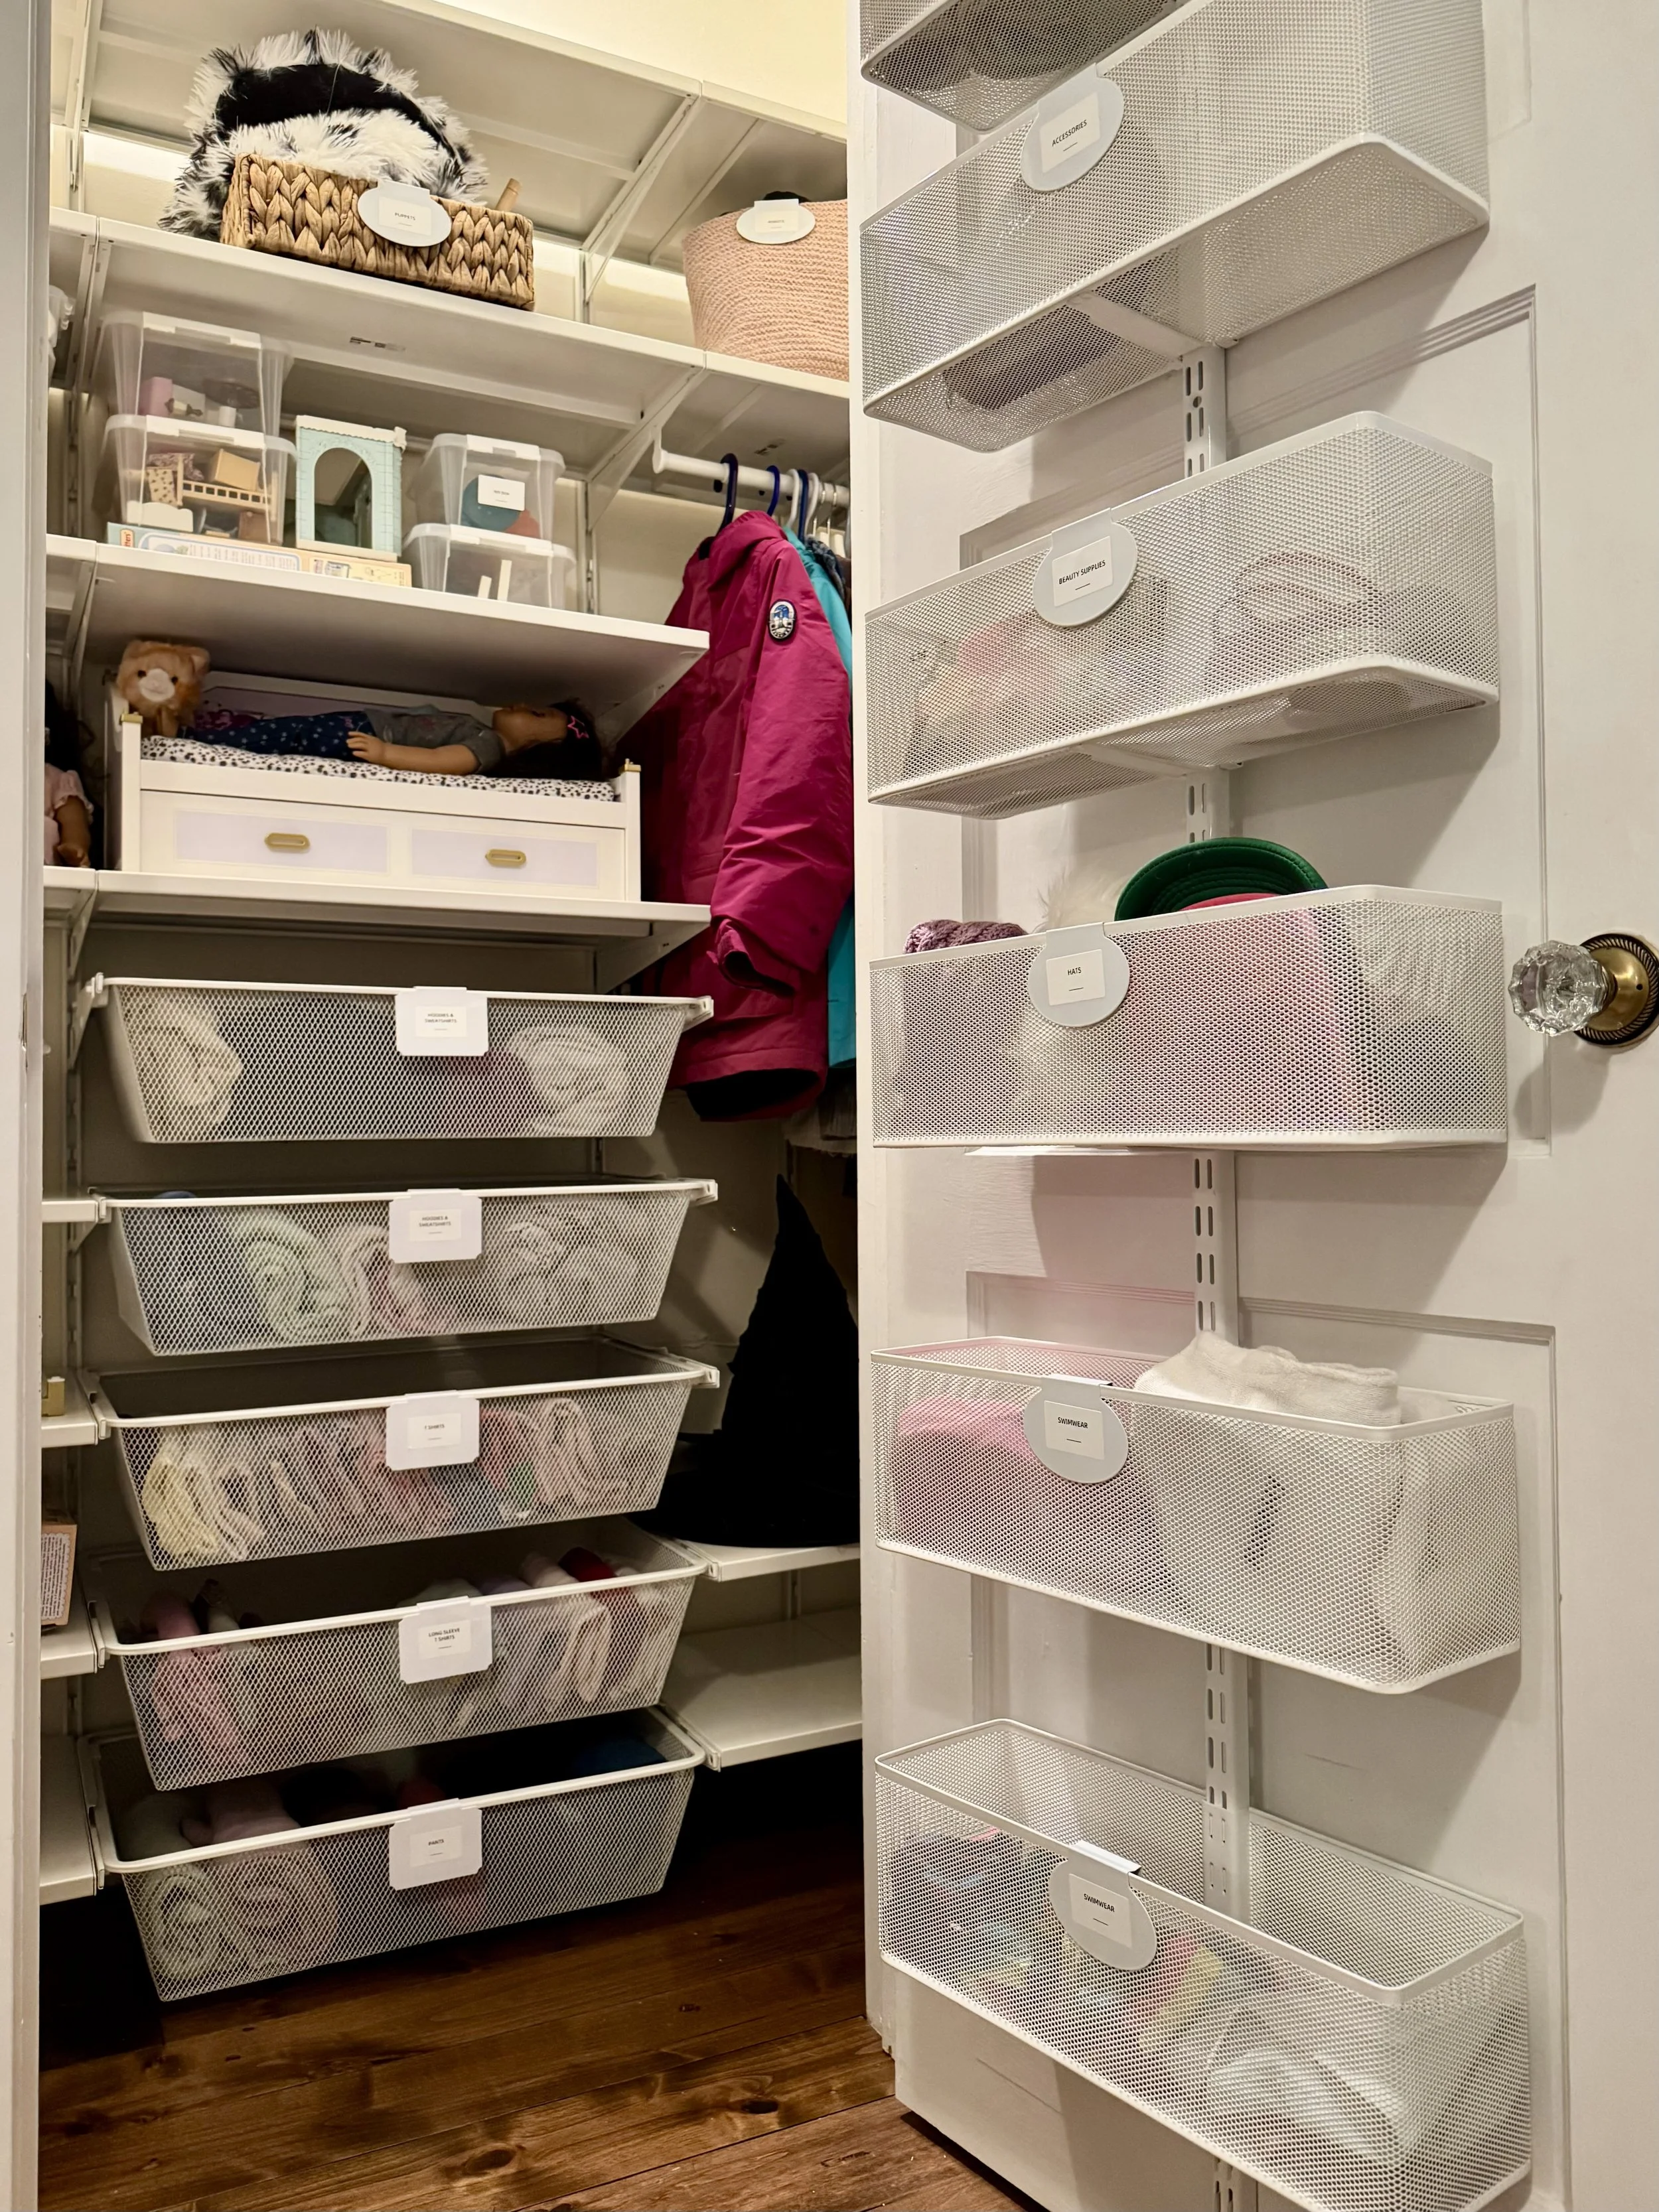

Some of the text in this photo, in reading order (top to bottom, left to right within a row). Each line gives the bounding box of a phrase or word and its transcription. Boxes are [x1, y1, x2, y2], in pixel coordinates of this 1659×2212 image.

[1052, 119, 1087, 147] ACCESSORIES
[394, 212, 416, 221] PUPPETS
[1058, 560, 1106, 585] BEAUTY SUPPLIES
[1067, 967, 1082, 975] HATS
[1058, 1417, 1088, 1428] SWIMWEAR
[1084, 1893, 1115, 1913] SWIMWEAR
